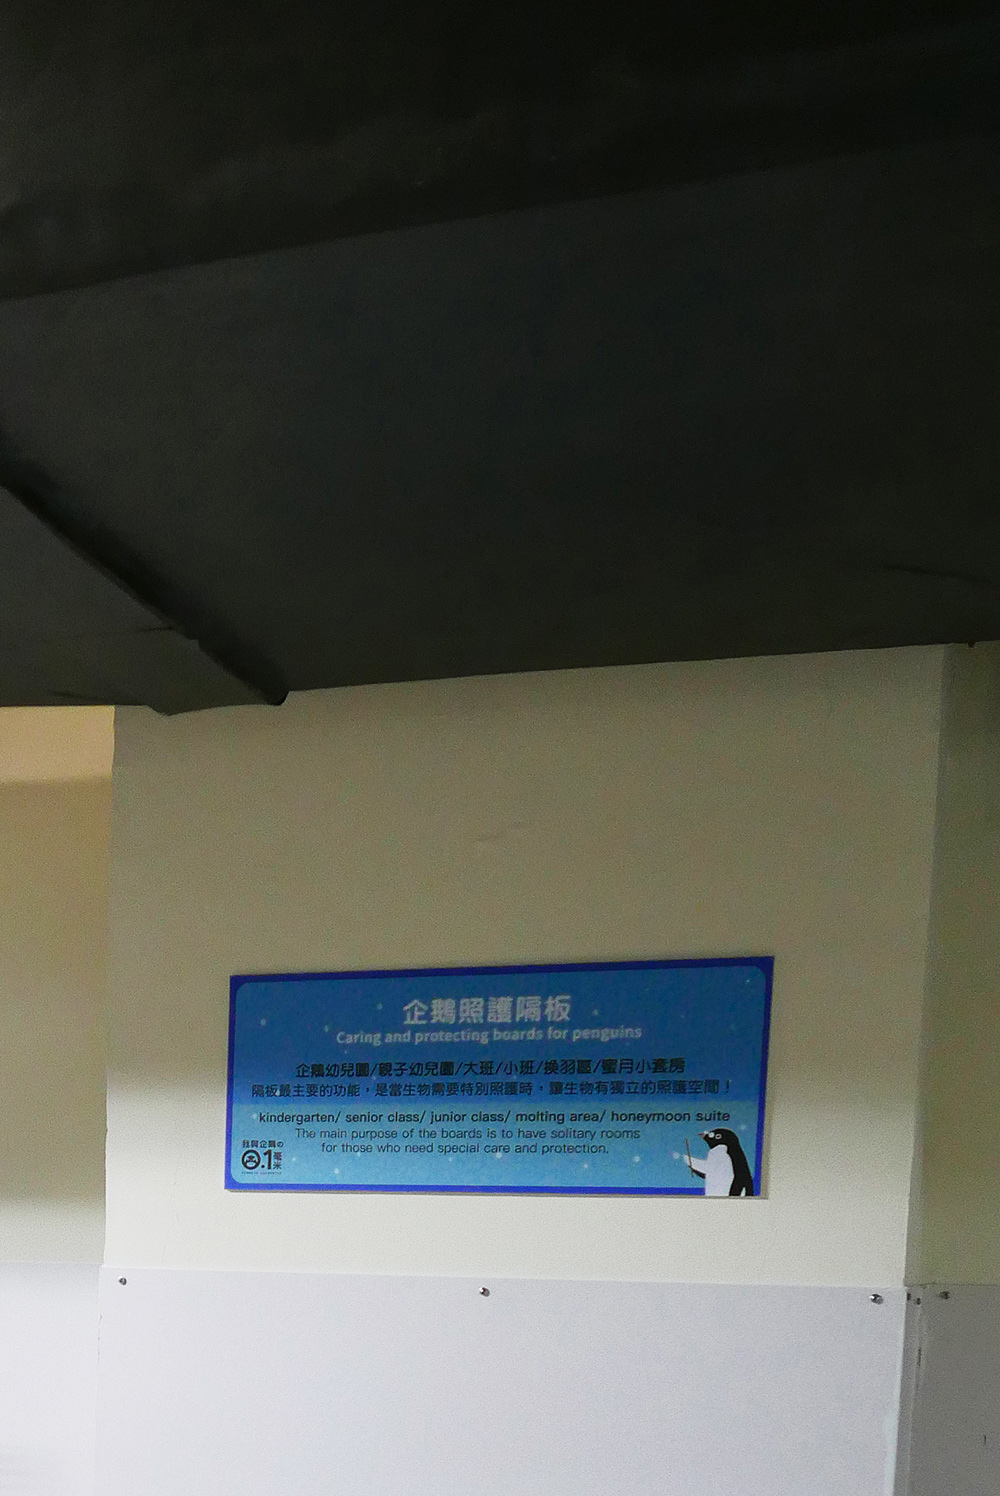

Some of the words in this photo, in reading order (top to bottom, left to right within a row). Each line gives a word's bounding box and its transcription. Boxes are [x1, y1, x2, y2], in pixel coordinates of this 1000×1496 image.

[402, 995, 572, 1026] 企鵝照護隔板
[336, 1030, 382, 1046] Caring
[385, 1029, 411, 1043] and
[415, 1027, 489, 1045] protecting
[493, 1027, 543, 1041] boards
[547, 1025, 568, 1040] for
[572, 1024, 643, 1041] penguins
[259, 1110, 342, 1126] kindergarten/
[345, 1111, 384, 1123] senior
[387, 1110, 427, 1123] class/
[429, 1110, 467, 1125] junior
[470, 1109, 512, 1123] class/
[515, 1110, 566, 1124] molting
[569, 1109, 605, 1123] area/
[610, 1110, 692, 1125] honeymoon
[695, 1109, 731, 1122] suite
[296, 1128, 317, 1139] The
[320, 1128, 348, 1139] main
[351, 1131, 397, 1141] purpose
[402, 1128, 416, 1139] of
[419, 1128, 438, 1139] the
[441, 1128, 483, 1139] boards
[486, 1128, 498, 1139] is
[501, 1128, 514, 1139] to
[517, 1128, 547, 1139] have
[550, 1128, 597, 1141] solitary
[600, 1131, 642, 1140] rooms
[321, 1142, 338, 1153] for
[341, 1142, 374, 1153] those
[377, 1142, 401, 1153] who
[405, 1142, 435, 1153] need
[438, 1142, 481, 1156] special
[484, 1145, 511, 1154] care
[514, 1142, 538, 1154] and
[541, 1143, 610, 1156] protection.
